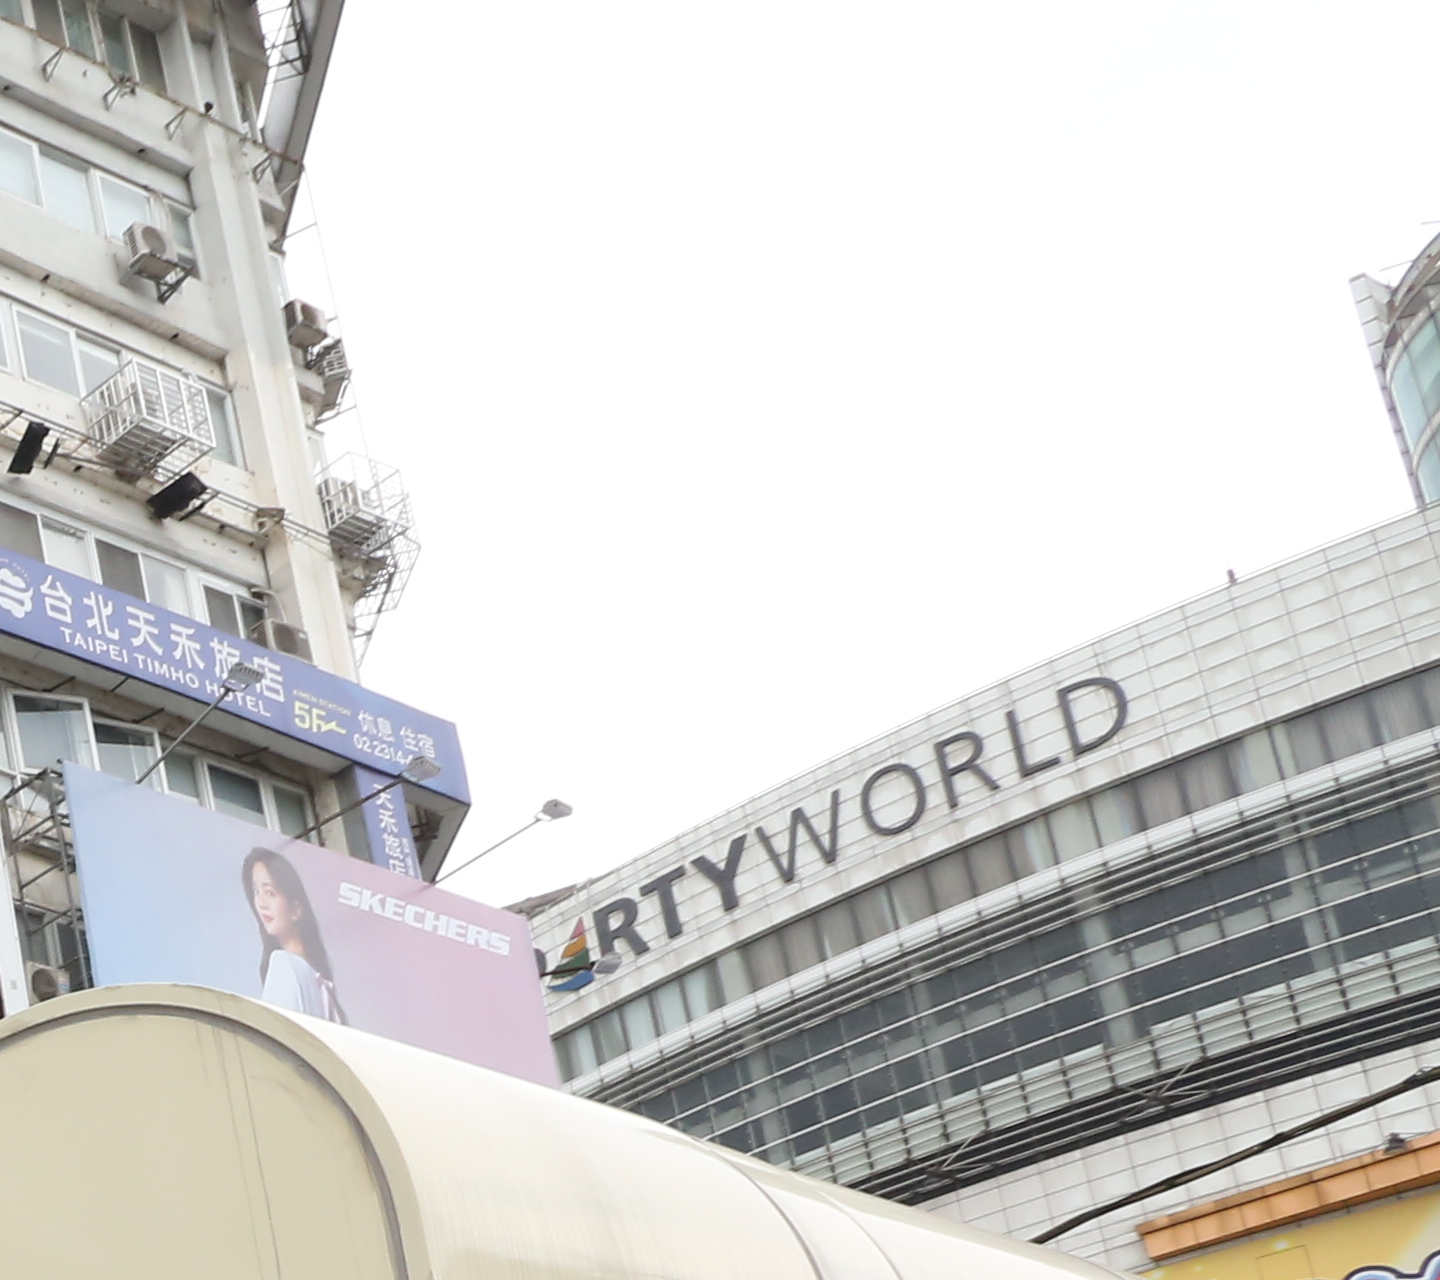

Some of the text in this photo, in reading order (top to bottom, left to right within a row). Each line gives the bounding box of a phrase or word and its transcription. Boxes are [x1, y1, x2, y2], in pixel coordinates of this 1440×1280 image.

[40, 575, 287, 703] 台北天禾旅店
[59, 627, 272, 718] TAIPEI TIMHO HOTEL
[293, 700, 327, 733] 5F
[358, 709, 437, 758] 休息 住宿
[337, 880, 511, 955] SKECHERS
